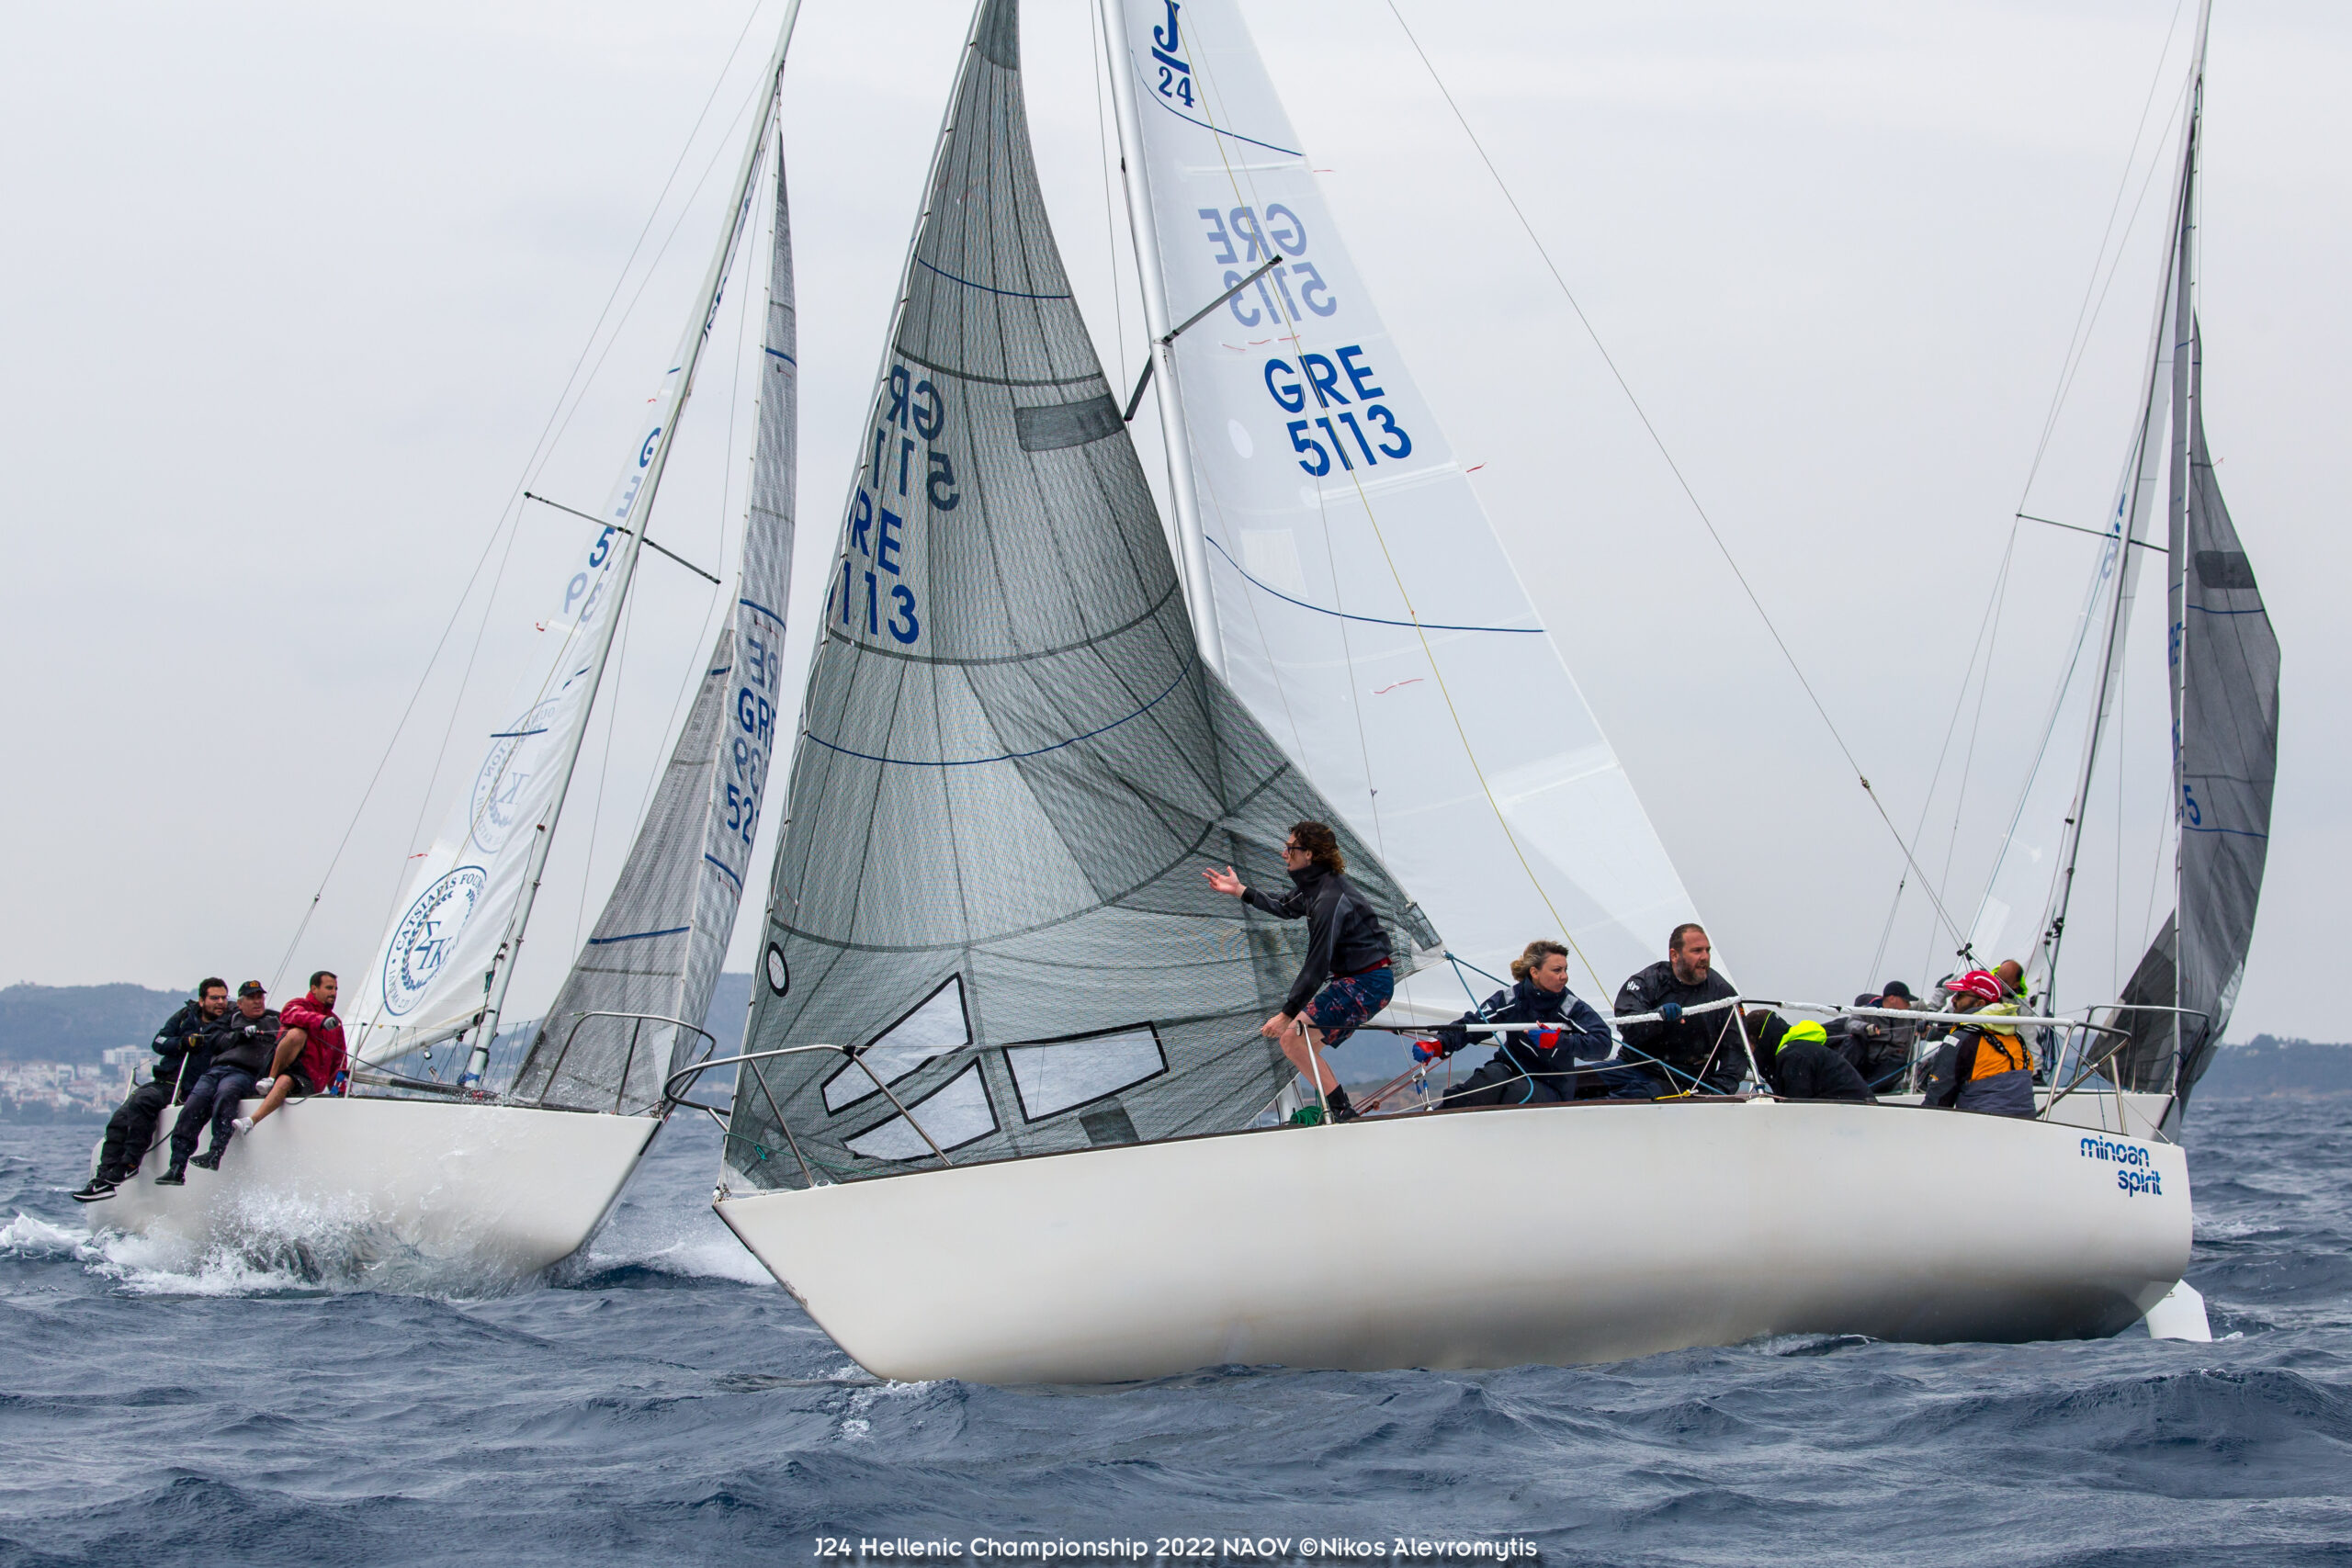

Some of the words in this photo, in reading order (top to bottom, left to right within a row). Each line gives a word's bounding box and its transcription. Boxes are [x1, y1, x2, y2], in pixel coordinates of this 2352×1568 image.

[1159, 66, 1194, 107] 24
[1264, 344, 1385, 413] GRE
[1286, 404, 1412, 477] 5113
[849, 485, 902, 576] RE
[827, 559, 919, 644] 113
[2080, 1134, 2150, 1168] minoan
[2118, 1168, 2162, 1198] spirit
